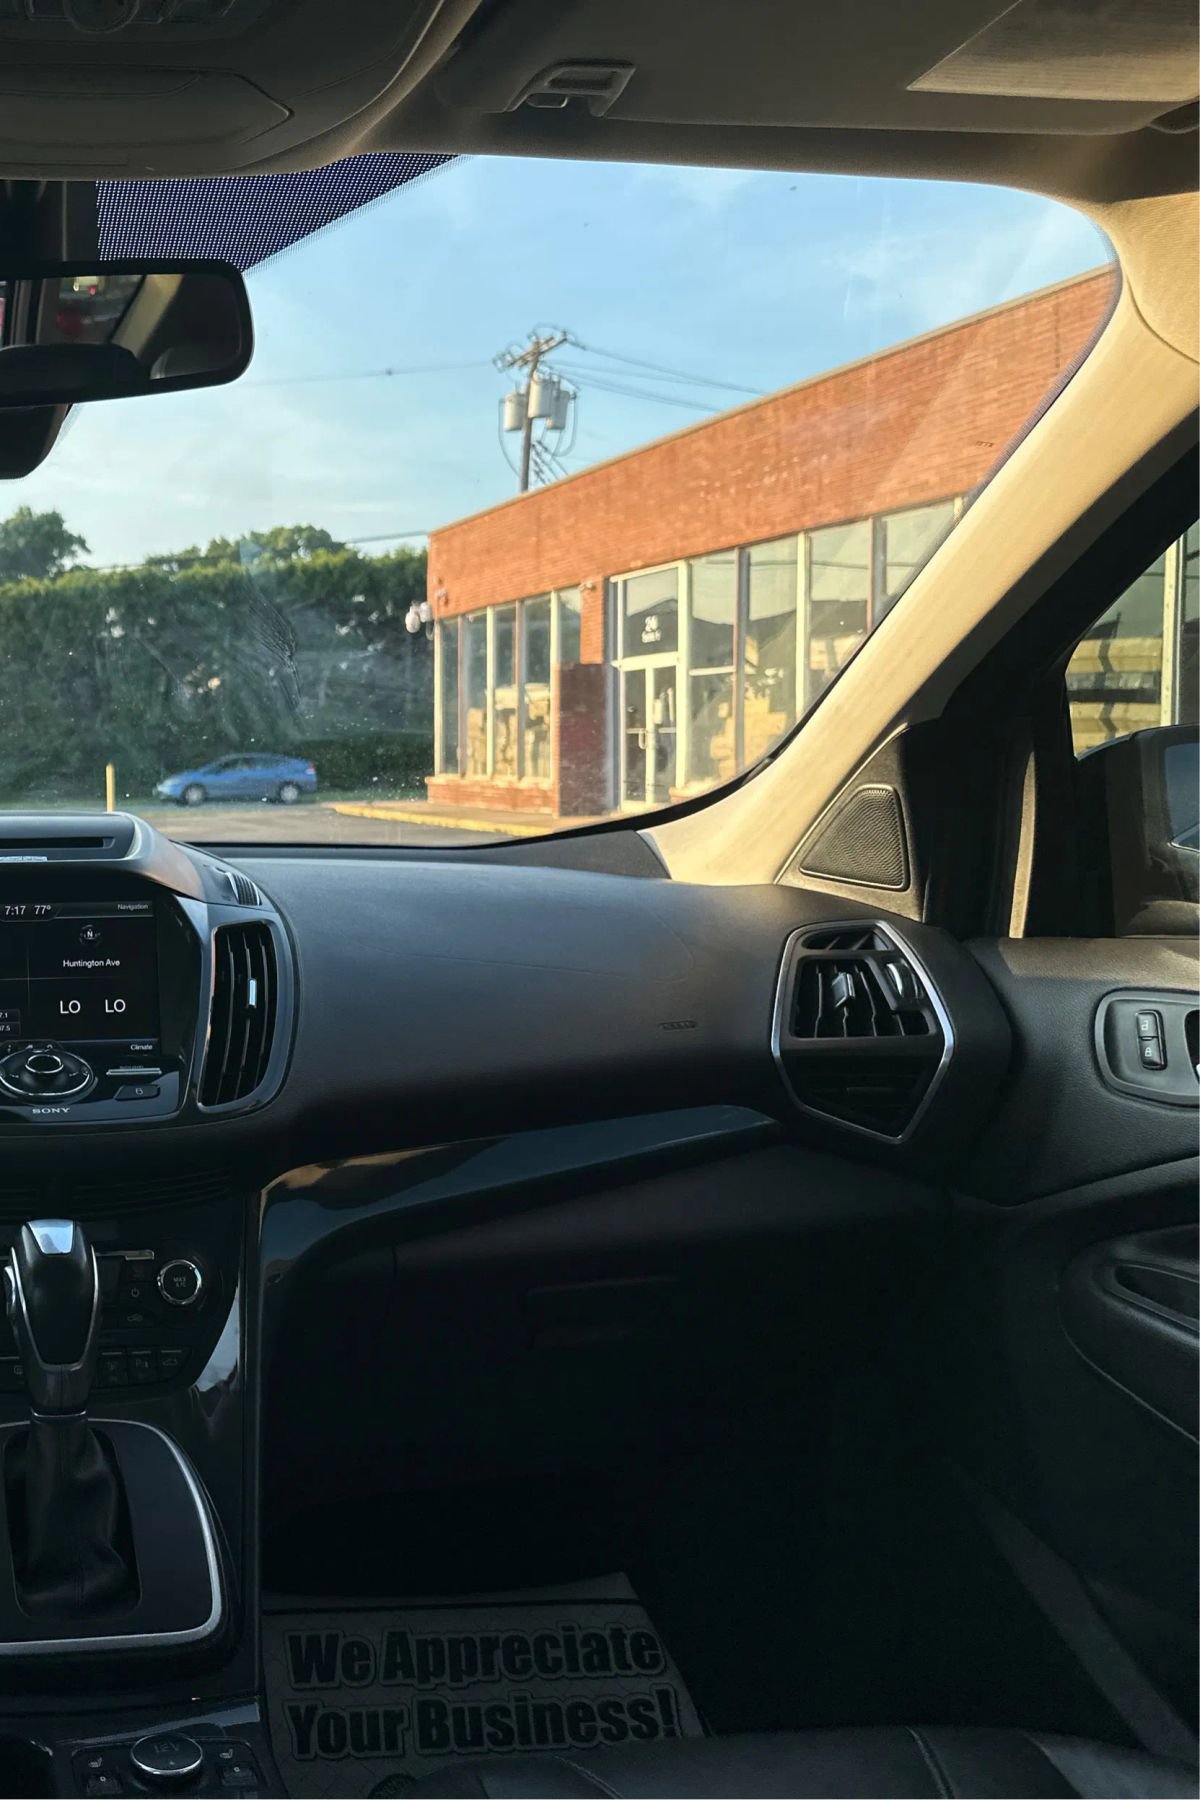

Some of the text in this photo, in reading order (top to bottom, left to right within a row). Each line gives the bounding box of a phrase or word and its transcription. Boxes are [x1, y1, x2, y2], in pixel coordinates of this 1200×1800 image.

[4, 904, 52, 916] 7:17 77°
[117, 903, 148, 911] Navigation
[62, 958, 121, 968] Huntington Ave
[59, 999, 81, 1014] LO
[104, 998, 127, 1013] LO
[130, 1043, 153, 1051] Climate
[287, 1623, 663, 1684] We Appreciate
[287, 1688, 680, 1756] Your Business!
